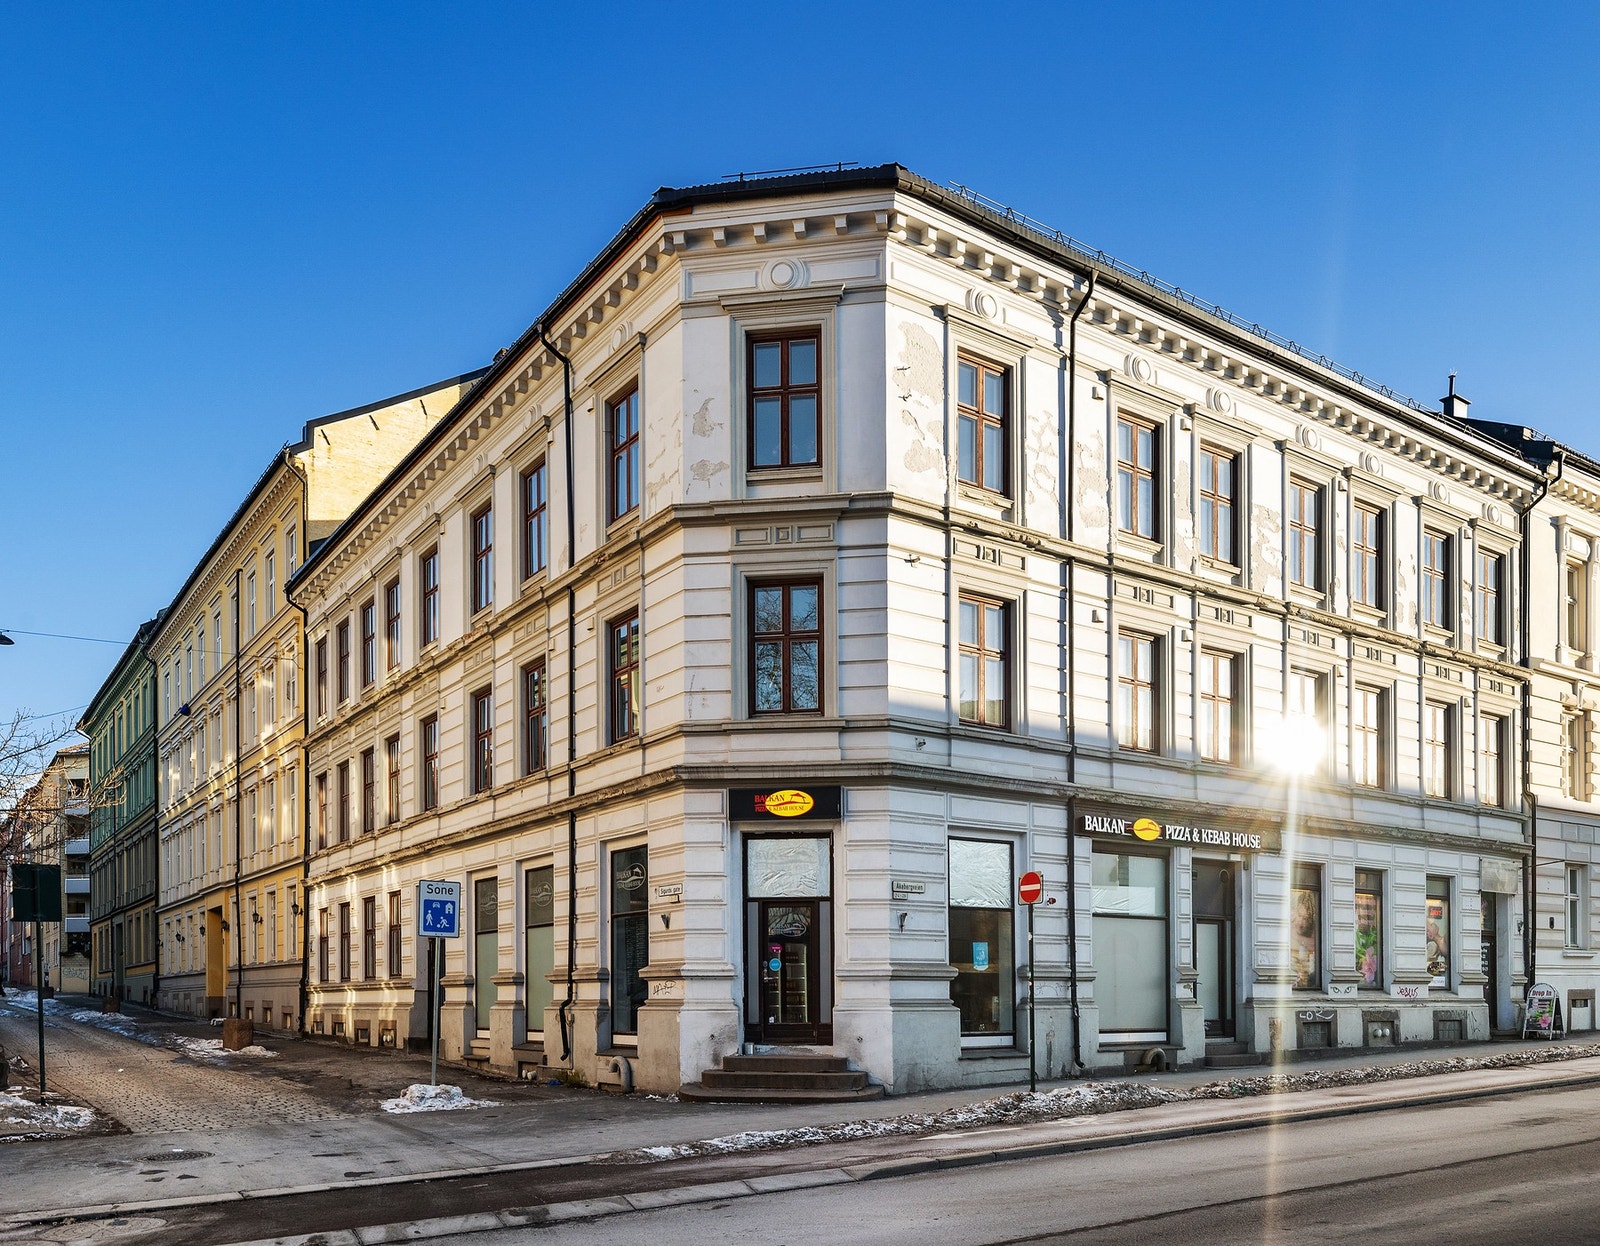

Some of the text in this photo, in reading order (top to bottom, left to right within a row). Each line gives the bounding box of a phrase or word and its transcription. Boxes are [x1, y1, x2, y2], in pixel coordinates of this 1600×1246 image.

[754, 795, 785, 803] BALKAN
[1084, 815, 1261, 849] BALKAN PIZZA & KEBAB HOUSE
[426, 884, 454, 895] Sone
[1531, 989, 1545, 997] Drop
